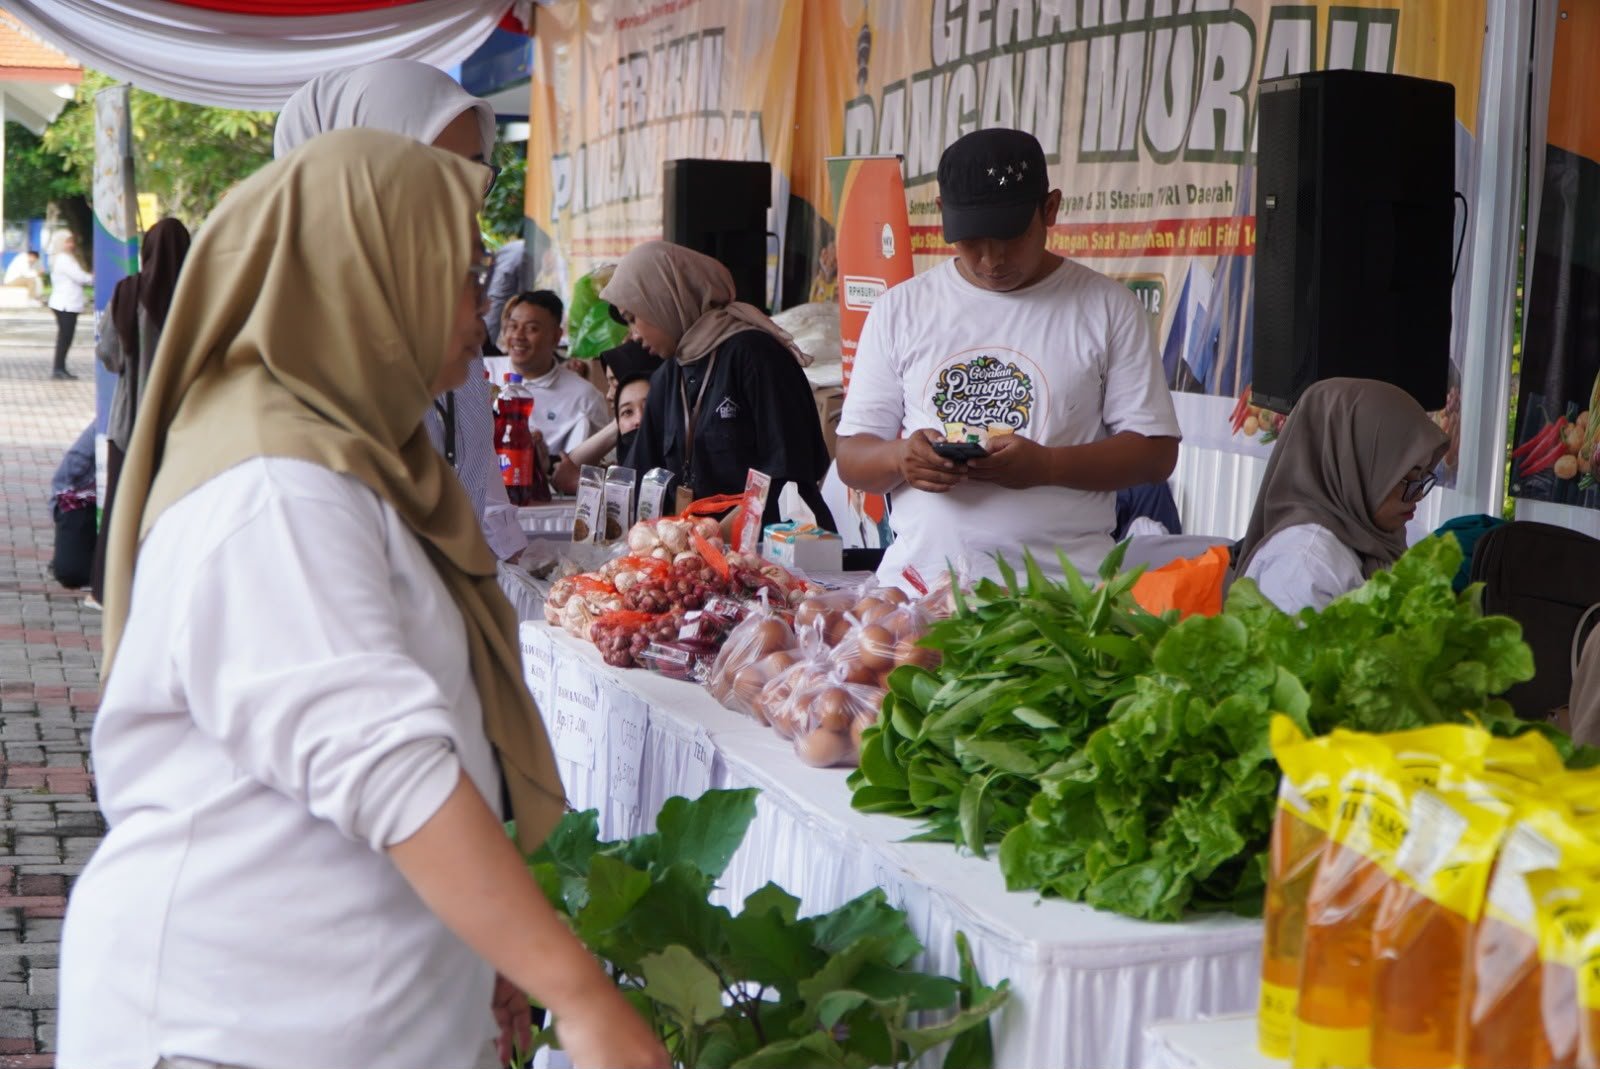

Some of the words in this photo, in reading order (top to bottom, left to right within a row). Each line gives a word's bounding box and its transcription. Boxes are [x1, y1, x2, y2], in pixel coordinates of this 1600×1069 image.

[1110, 187, 1153, 210] Stasiun
[1186, 180, 1233, 205] Daerah
[1053, 231, 1089, 254] Pangan
[1092, 231, 1115, 250] Saat
[946, 369, 1027, 405] Pangan
[968, 363, 1013, 381] Gerakan
[942, 400, 1024, 430] Murah
